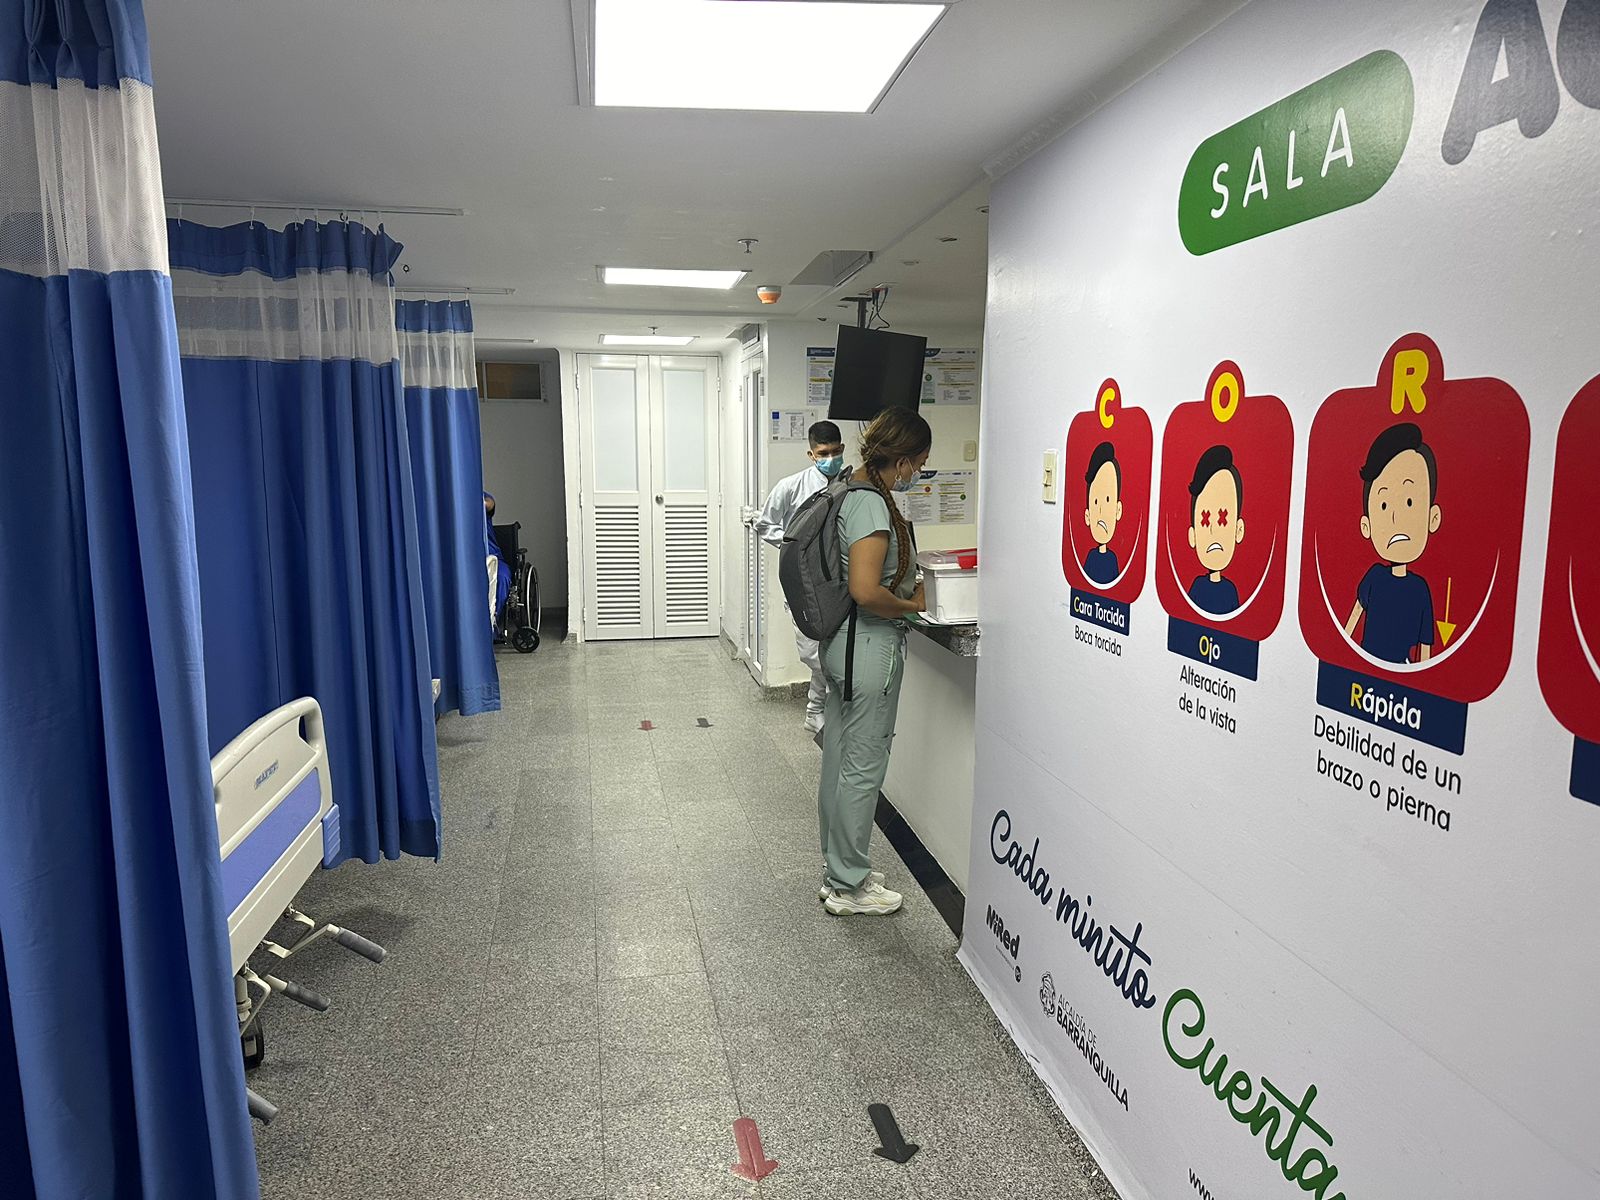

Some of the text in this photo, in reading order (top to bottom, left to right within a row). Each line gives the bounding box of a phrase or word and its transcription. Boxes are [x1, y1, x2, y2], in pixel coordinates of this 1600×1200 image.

[1210, 107, 1353, 218] SALA
[1211, 372, 1239, 423] O
[1390, 349, 1429, 415] R
[1099, 387, 1115, 429] C
[1073, 596, 1125, 628] Cara Torcida
[1074, 625, 1122, 657] Boca torcida
[1199, 635, 1221, 663] Ojo
[1179, 665, 1236, 703] Alteración
[1350, 682, 1422, 730] Rápida
[1178, 693, 1236, 734] de la vista
[1314, 714, 1461, 794] Debilidad de un
[1317, 749, 1451, 832] brazo o pierna
[991, 810, 1346, 1200] Cada minuto Cuenta
[1057, 1005, 1128, 1111] BARRANQUILLA
[1088, 1029, 1098, 1049] DE
